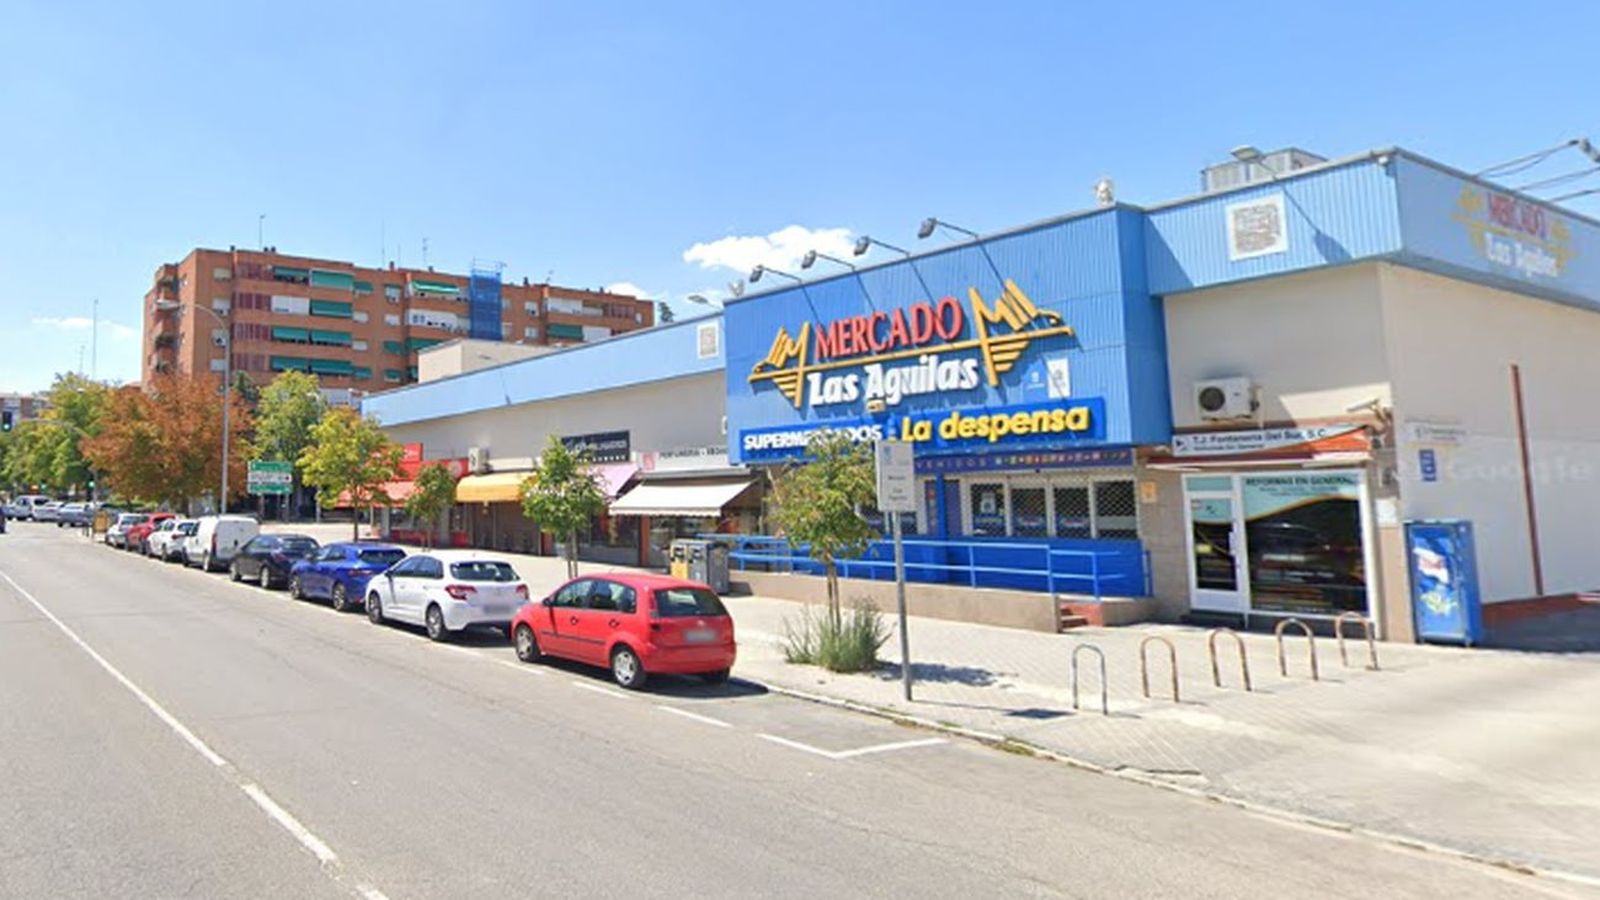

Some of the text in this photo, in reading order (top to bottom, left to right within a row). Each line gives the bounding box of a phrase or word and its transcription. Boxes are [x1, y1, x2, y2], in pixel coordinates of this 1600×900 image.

[814, 297, 964, 359] MERCADO
[807, 372, 860, 406] Las
[743, 424, 883, 450] SUPERMEDOS
[901, 416, 933, 443] La
[938, 407, 1091, 443] despensa
